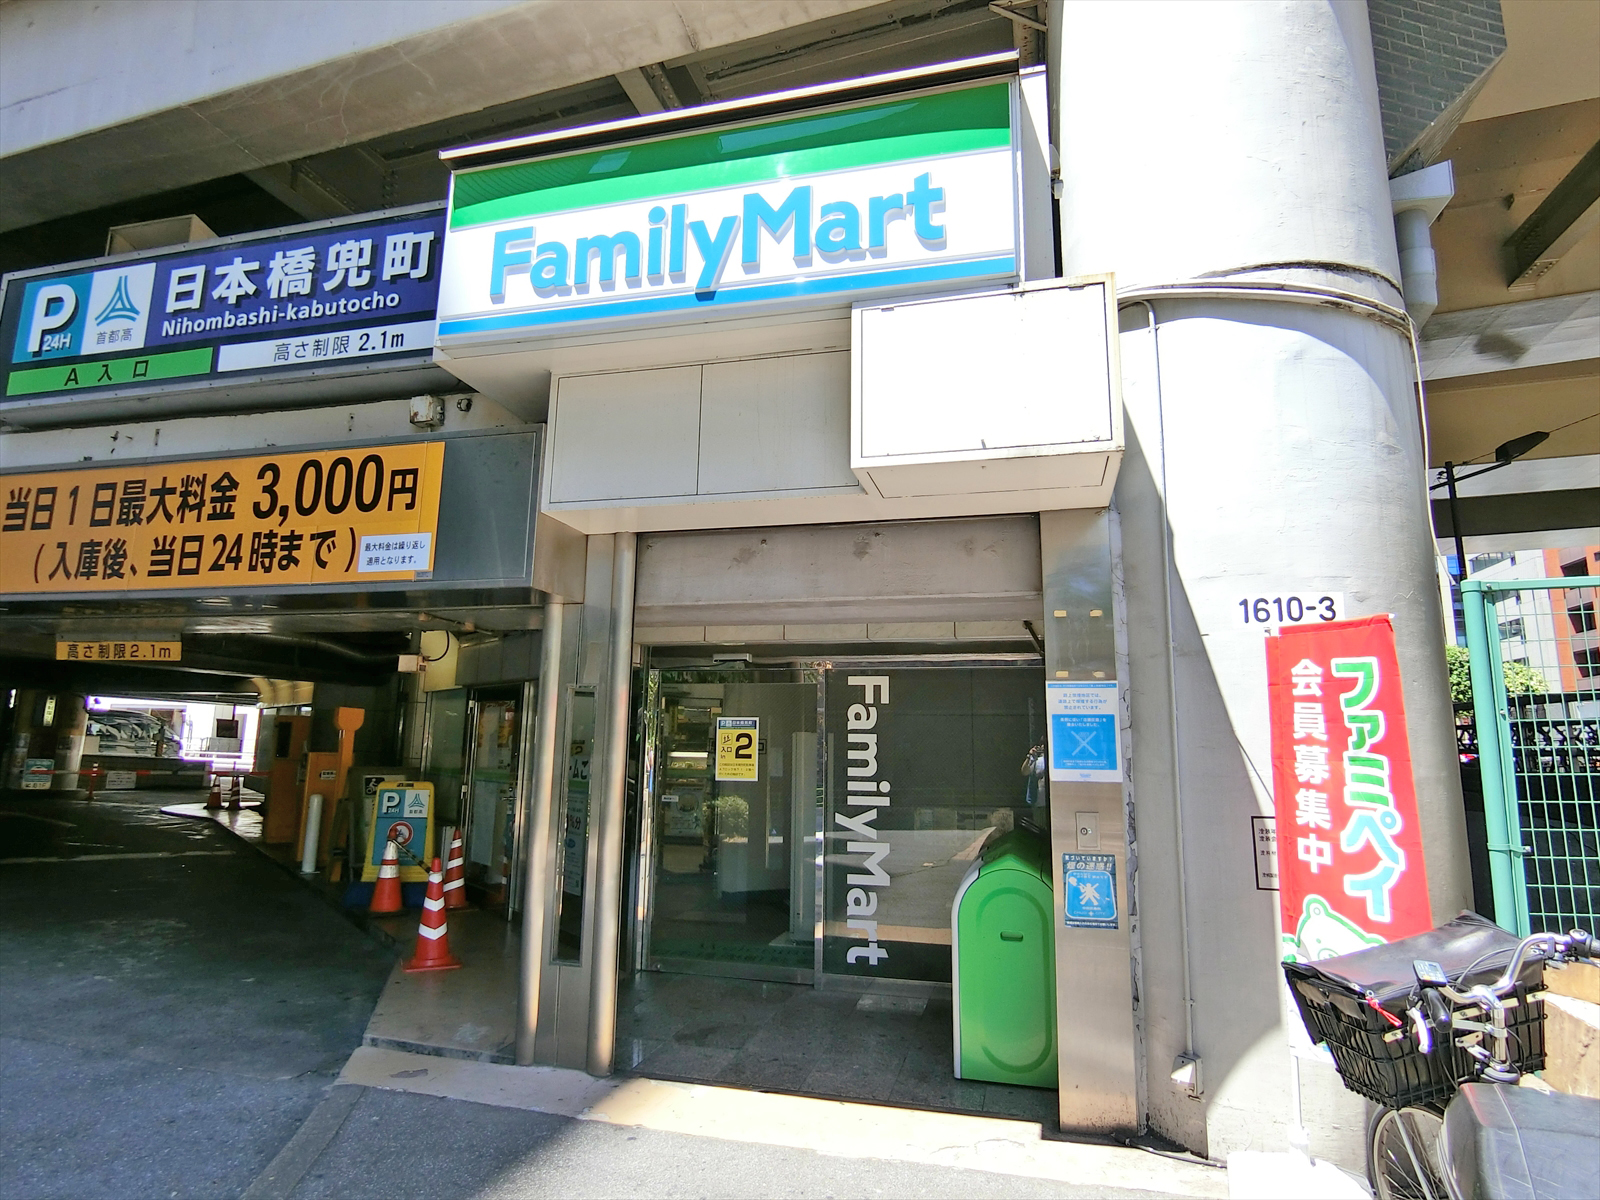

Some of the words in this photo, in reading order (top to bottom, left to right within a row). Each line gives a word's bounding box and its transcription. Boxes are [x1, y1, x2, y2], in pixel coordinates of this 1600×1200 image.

[490, 172, 946, 300] FamilyMart
[164, 230, 436, 313] 日本橋兜町
[27, 283, 77, 353] P
[161, 290, 400, 338] Nihombashi-kabutocho
[41, 333, 72, 352] 24H
[95, 327, 133, 346] 首都高
[273, 335, 350, 363] 高さ制限
[358, 330, 405, 353] 2.1m
[364, 540, 426, 552] 最大料金は繰り返し
[366, 555, 417, 566] 適用となります。
[1238, 596, 1337, 624] 1610-3
[735, 733, 752, 759] 2
[1290, 658, 1333, 874] 会員募集中
[382, 791, 400, 813] P
[1331, 656, 1405, 922] ファミペイ
[834, 675, 891, 966] FamilyMart
